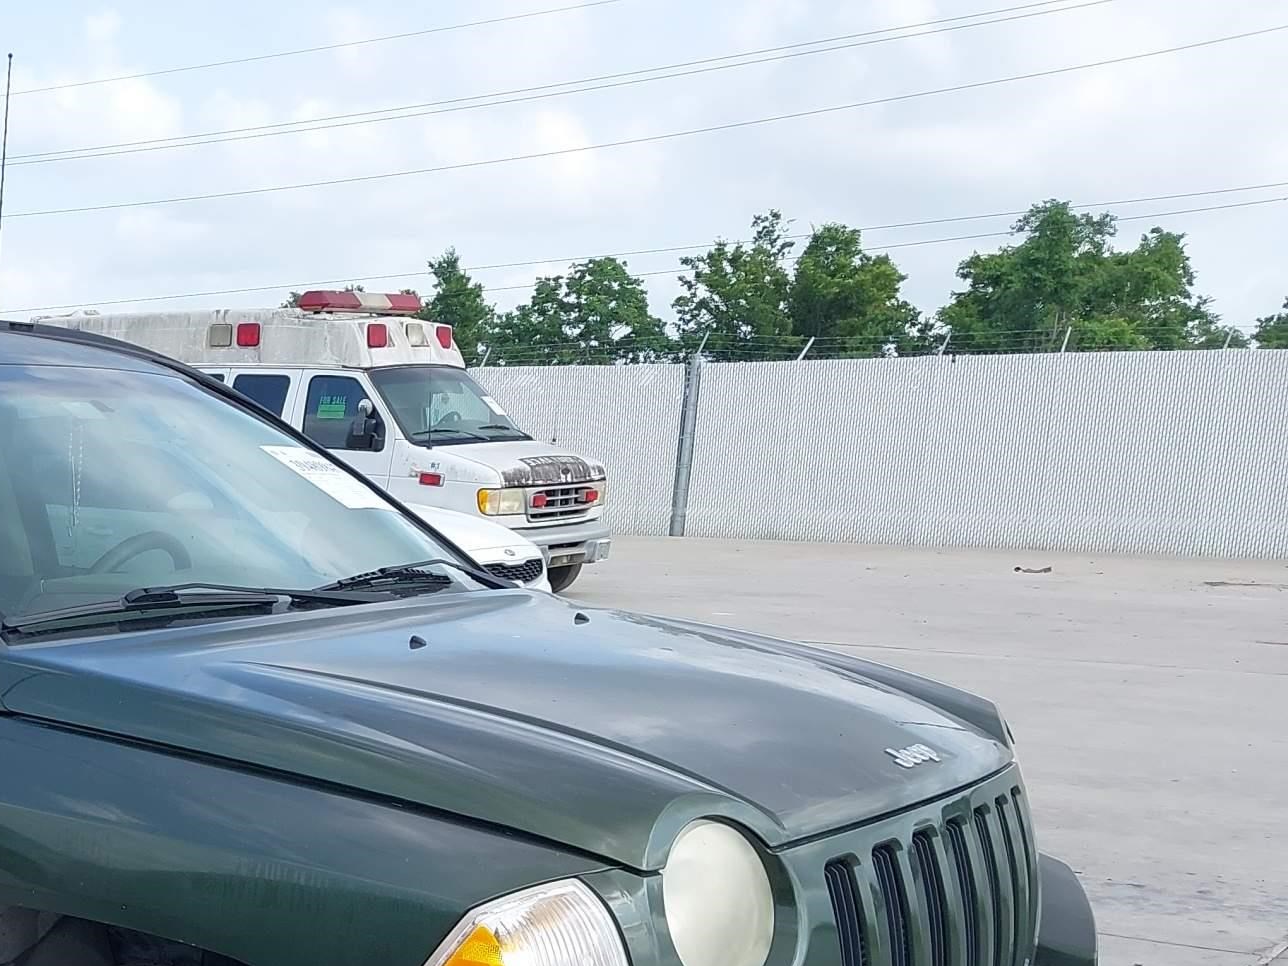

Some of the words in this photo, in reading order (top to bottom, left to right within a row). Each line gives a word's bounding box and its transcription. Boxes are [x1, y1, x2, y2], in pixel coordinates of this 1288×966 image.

[320, 395, 331, 405] FOR
[332, 395, 347, 405] SALE
[884, 743, 941, 768] Jeep
